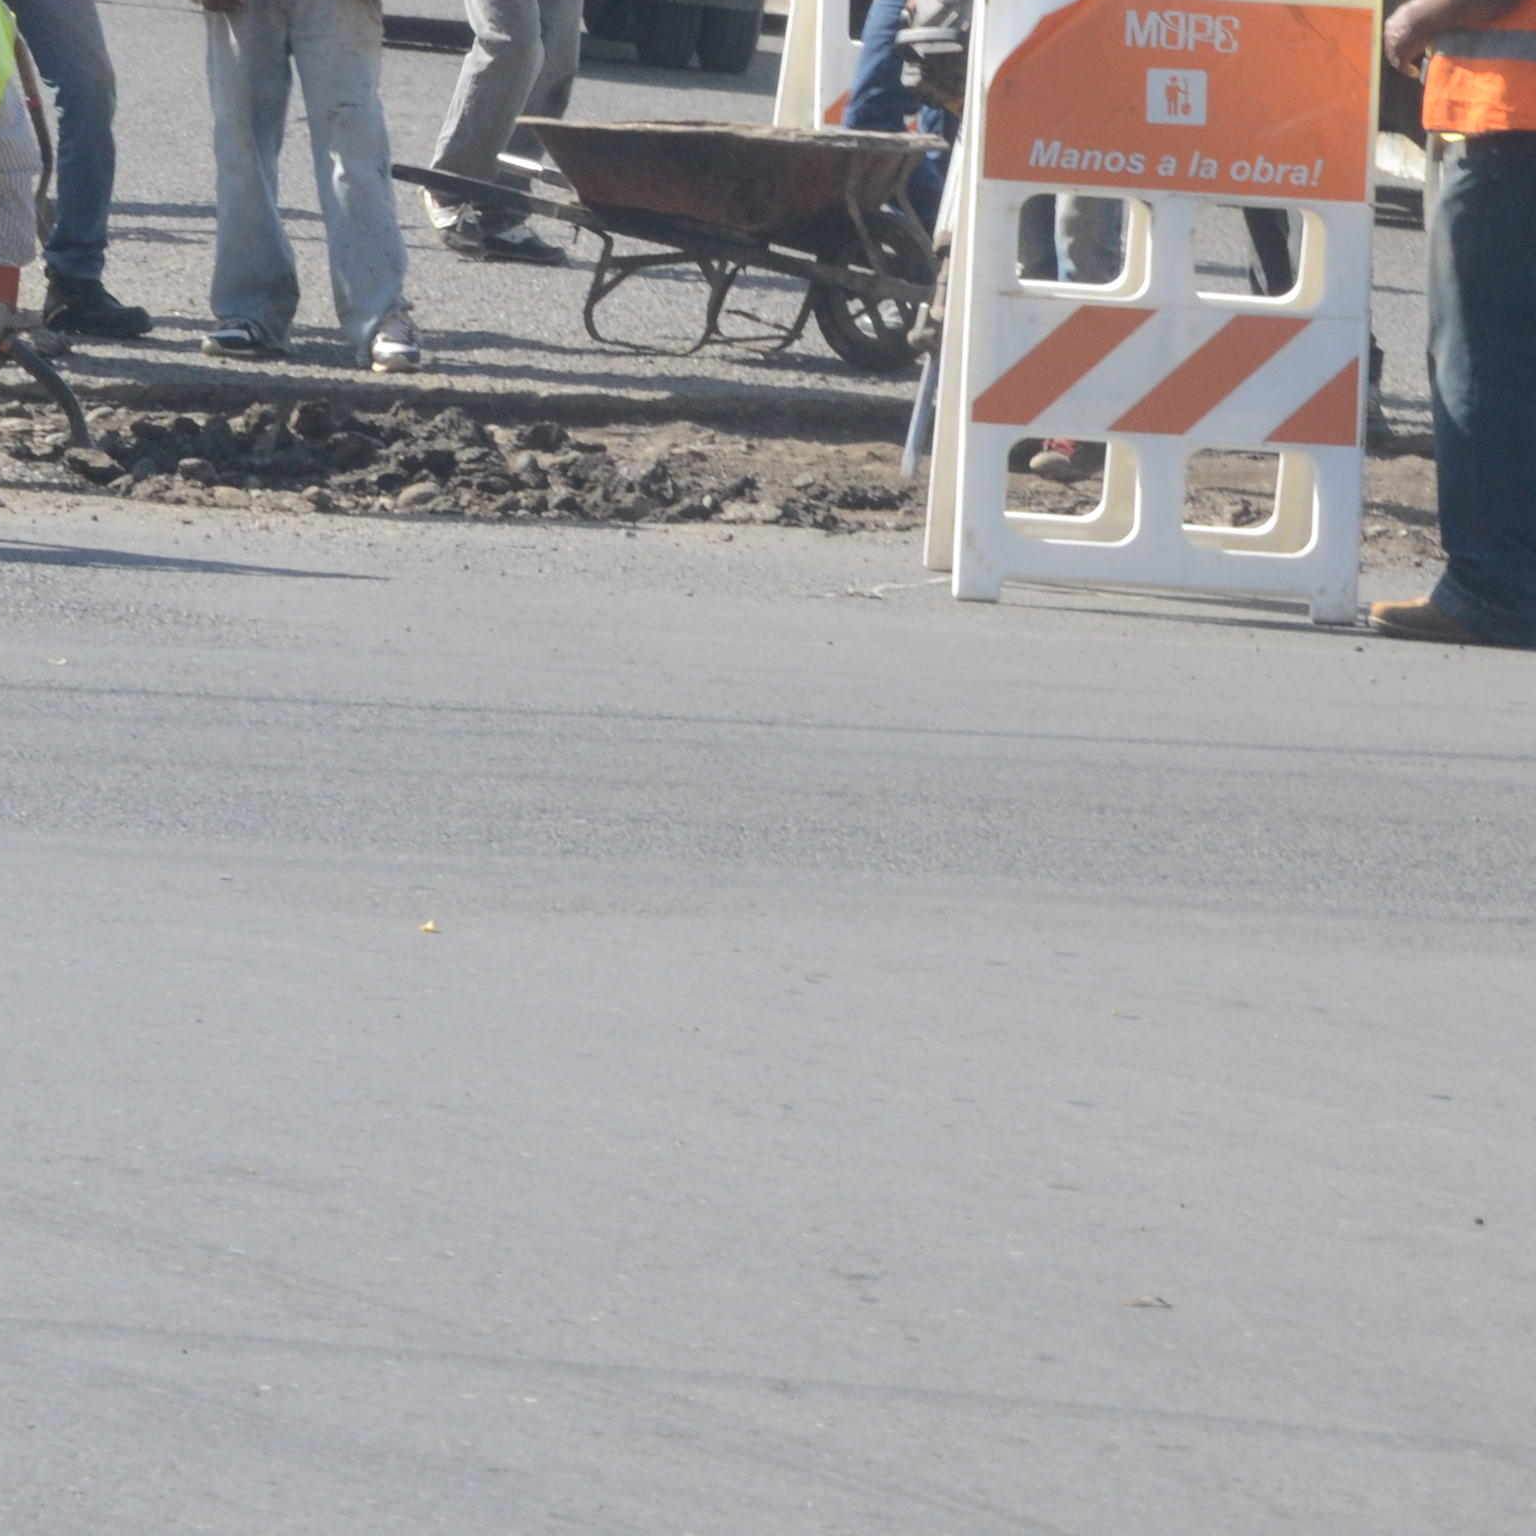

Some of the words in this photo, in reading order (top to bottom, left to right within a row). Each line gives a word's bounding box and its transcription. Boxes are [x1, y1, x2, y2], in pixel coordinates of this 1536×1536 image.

[1029, 139, 1147, 175] Manos
[1157, 156, 1178, 177] a
[1188, 151, 1219, 180] la
[1230, 156, 1324, 186] obra!
